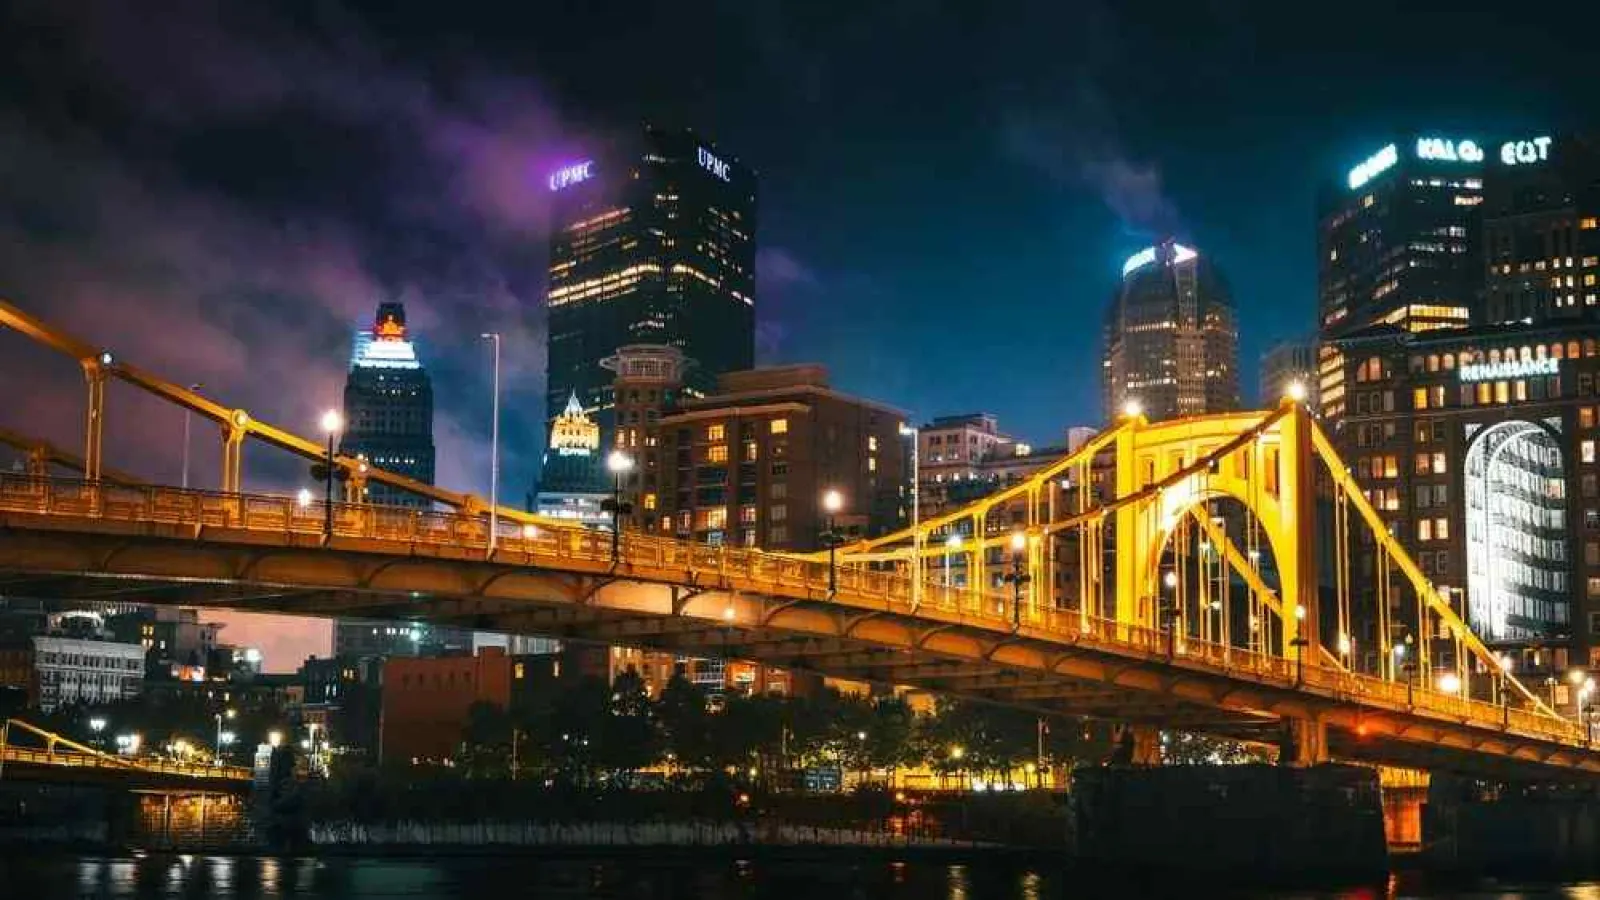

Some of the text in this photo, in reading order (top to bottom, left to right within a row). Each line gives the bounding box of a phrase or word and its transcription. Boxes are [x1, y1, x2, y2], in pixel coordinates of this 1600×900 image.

[550, 160, 594, 191] UPMC
[697, 146, 731, 182] UPMC
[1460, 358, 1558, 382] RENAISSANCE
